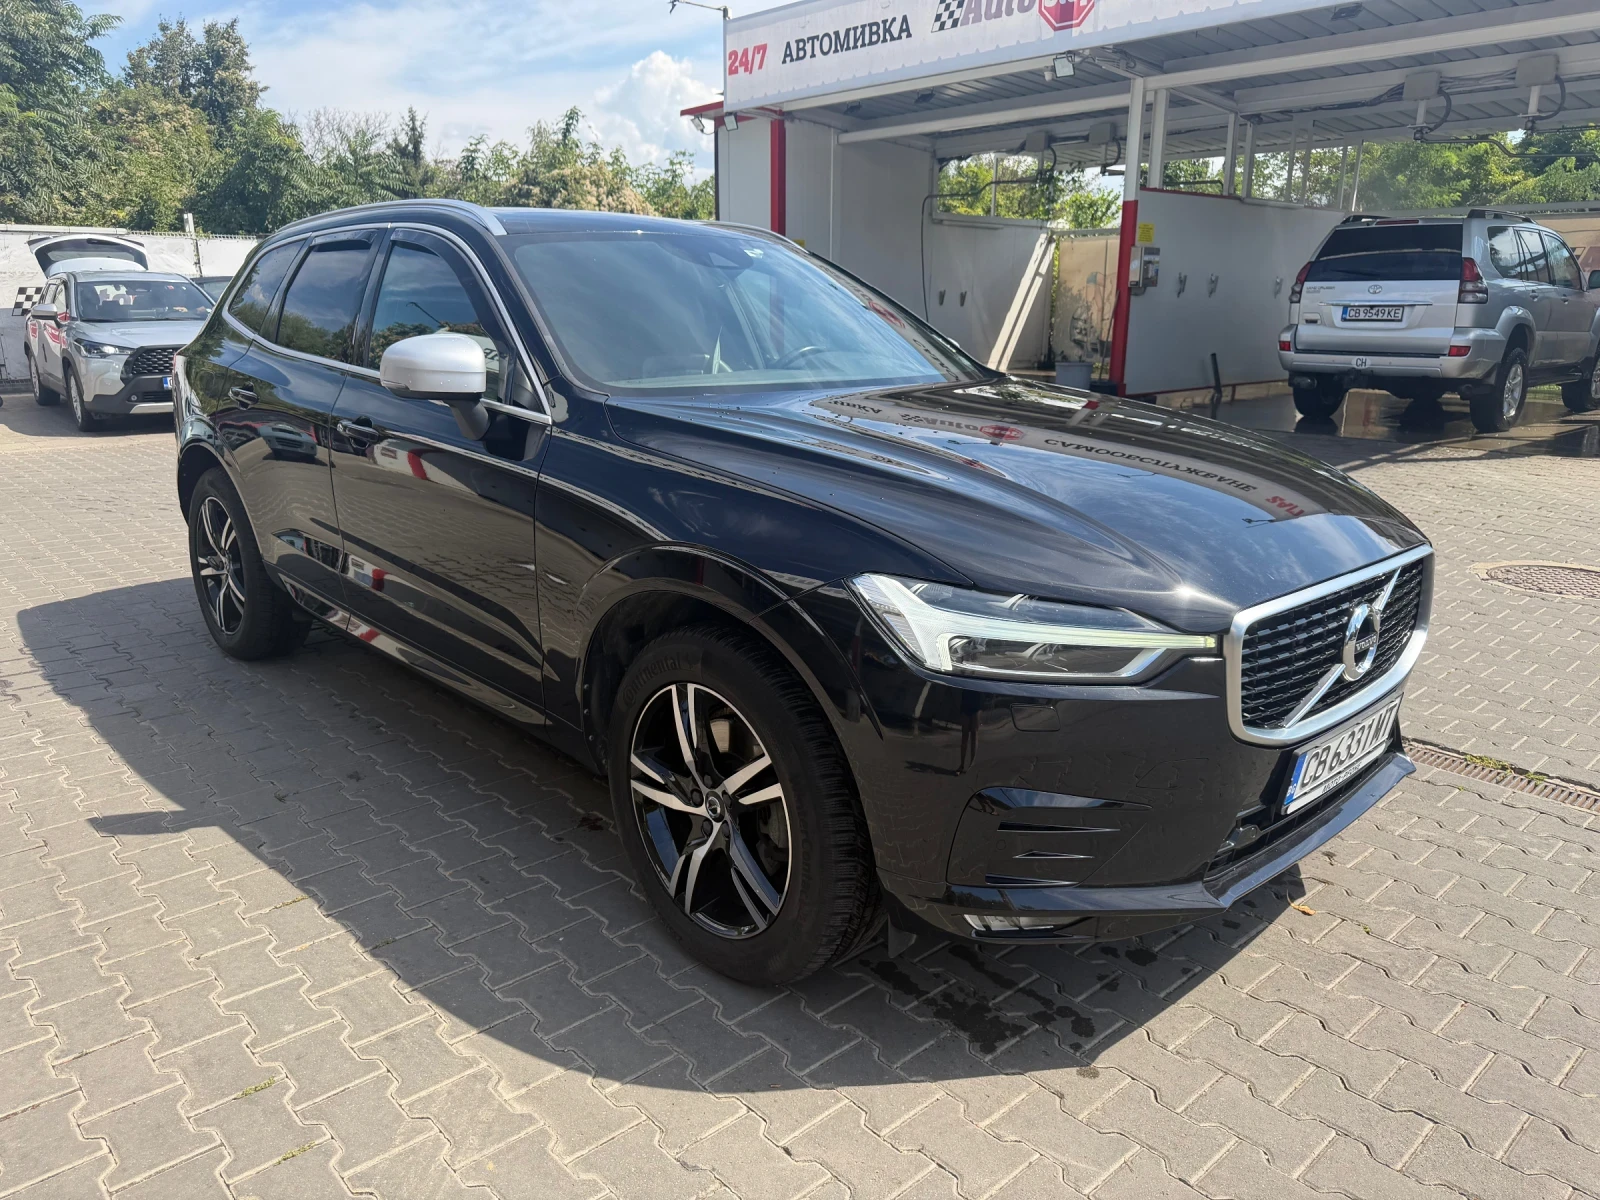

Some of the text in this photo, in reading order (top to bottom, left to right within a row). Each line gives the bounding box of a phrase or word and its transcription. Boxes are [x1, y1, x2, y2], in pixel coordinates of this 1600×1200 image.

[728, 14, 912, 76] 24/7 АВТОМИВКА
[1355, 357, 1367, 367] CH
[1356, 636, 1376, 650] VOLVO
